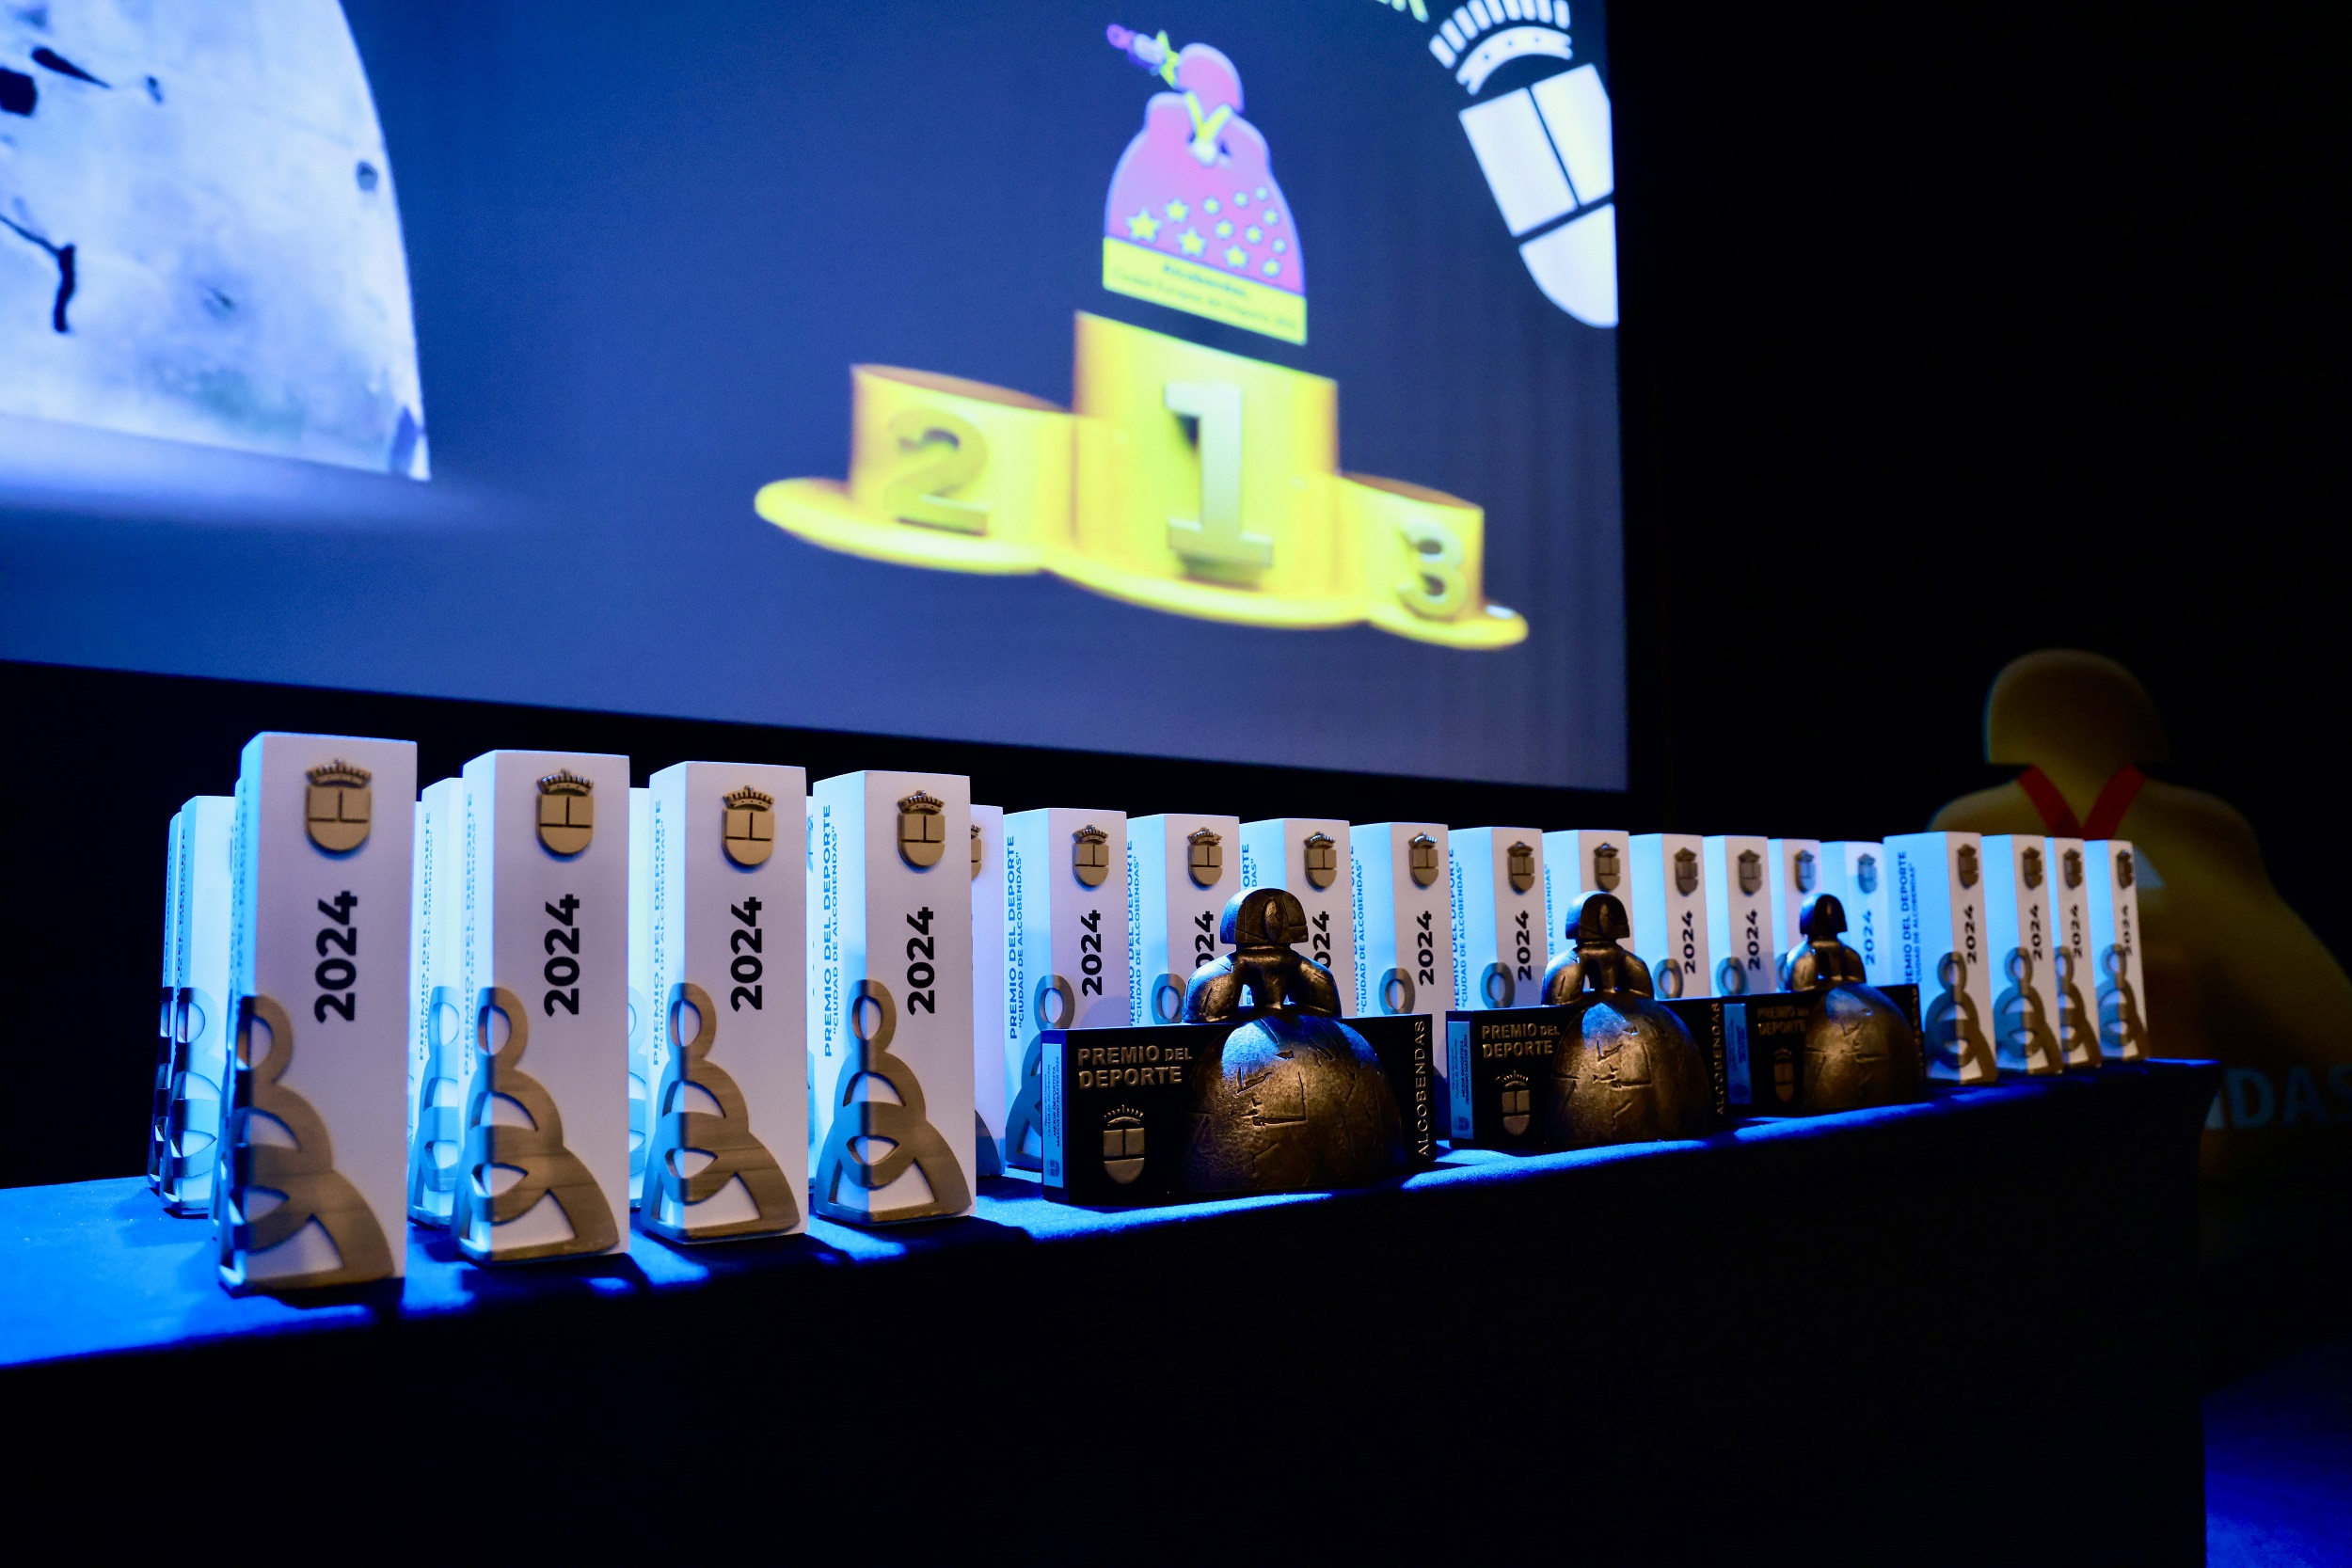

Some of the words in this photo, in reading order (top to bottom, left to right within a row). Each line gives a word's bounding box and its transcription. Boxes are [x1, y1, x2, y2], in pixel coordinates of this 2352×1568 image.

[884, 408, 988, 535] 2
[1163, 381, 1273, 567] 1
[1397, 520, 1467, 622] 3
[1007, 835, 1015, 921] DEPORTE
[313, 890, 358, 1023] 2024
[544, 894, 580, 1018] 2024
[730, 896, 762, 1013] 2024
[833, 941, 838, 961] DE
[1080, 910, 1102, 997] 2024
[1136, 948, 1141, 965] DE
[1194, 911, 1214, 970] 024
[1312, 911, 1330, 970] 024
[1359, 944, 1365, 959] DE
[1417, 911, 1434, 986] 2024
[1459, 943, 1466, 957] DE
[1516, 911, 1532, 982] 2024
[1549, 942, 1555, 955] DE
[1682, 911, 1695, 974] 2024
[1746, 910, 1760, 971] 2024
[1863, 910, 1875, 965] 2024
[1902, 915, 1911, 940] DEL
[1963, 905, 1977, 964] 2024
[2029, 905, 2042, 960] 2024
[2070, 904, 2082, 958] 2024
[906, 907, 934, 1016] 2024
[1017, 949, 1024, 967] DE
[1077, 1045, 1160, 1067] PREMIO
[1165, 1047, 1193, 1062] DEL
[1482, 1022, 1537, 1039] PREMIO
[1540, 1025, 1560, 1037] DEL
[1482, 1039, 1553, 1059] DEPORTE
[1710, 1003, 1724, 1116] ALCOBENDAS
[1078, 1066, 1182, 1089] DEPORTE
[1414, 1021, 1429, 1156] ALCOBENDAS
